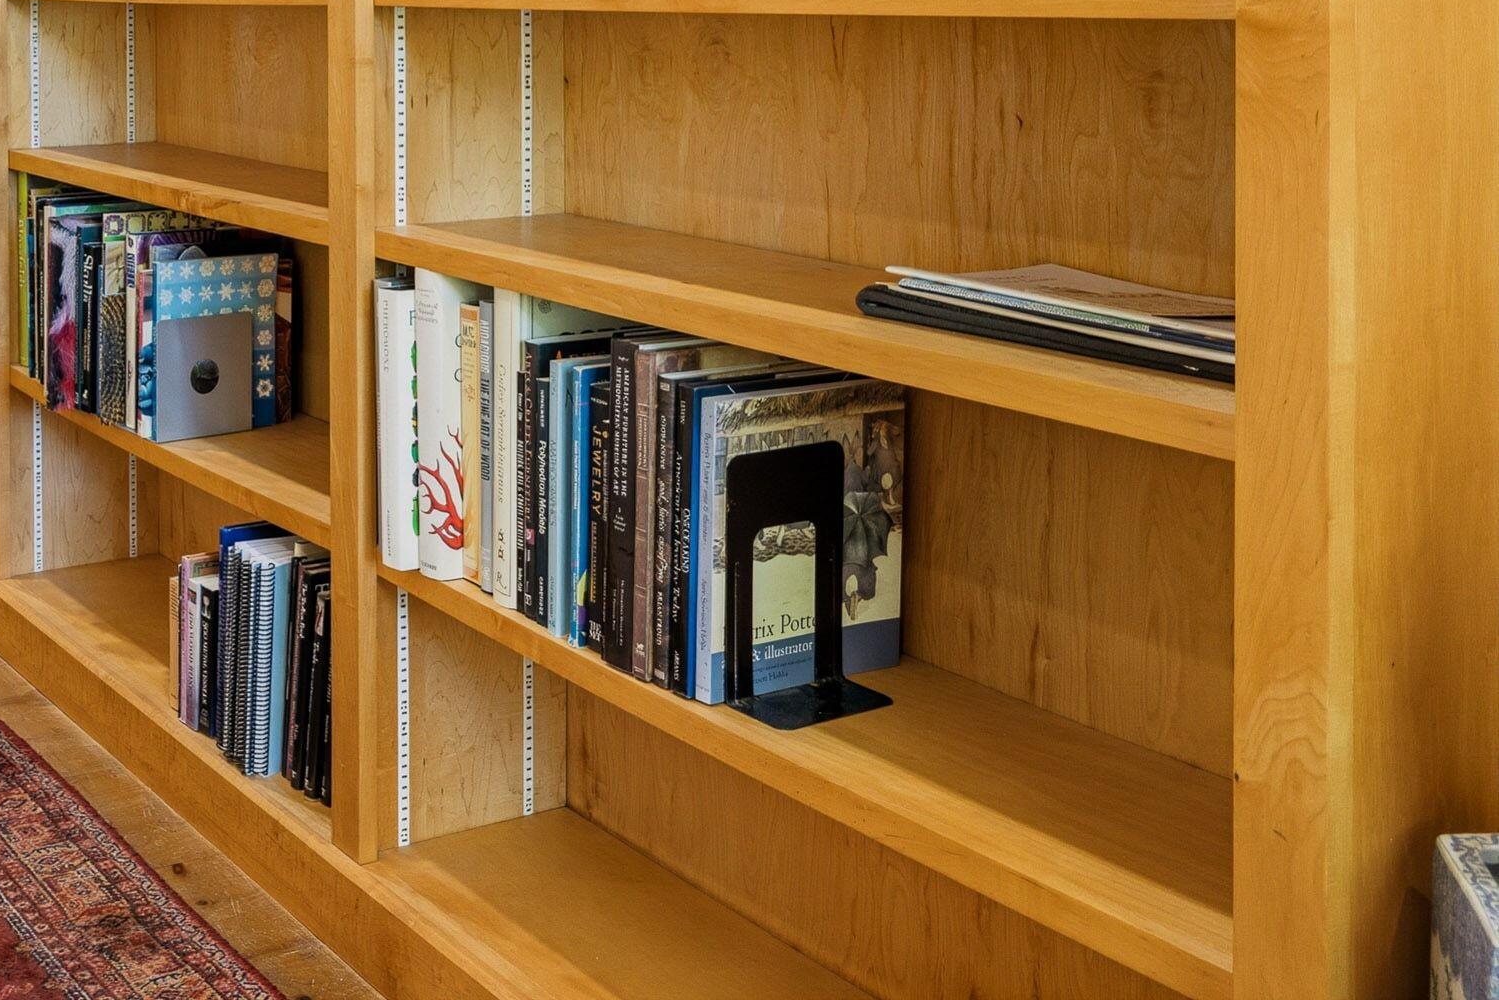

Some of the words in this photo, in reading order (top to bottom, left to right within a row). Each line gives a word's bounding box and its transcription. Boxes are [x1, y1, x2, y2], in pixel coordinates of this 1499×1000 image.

[480, 378, 490, 395] THE
[480, 397, 490, 418] FINE
[480, 419, 490, 437] ART
[480, 440, 490, 453] OF
[538, 440, 548, 496] Polyhedron
[592, 424, 602, 515] JEWELRY
[675, 451, 683, 512] American
[538, 497, 547, 535] Models
[764, 641, 813, 660] illustrator
